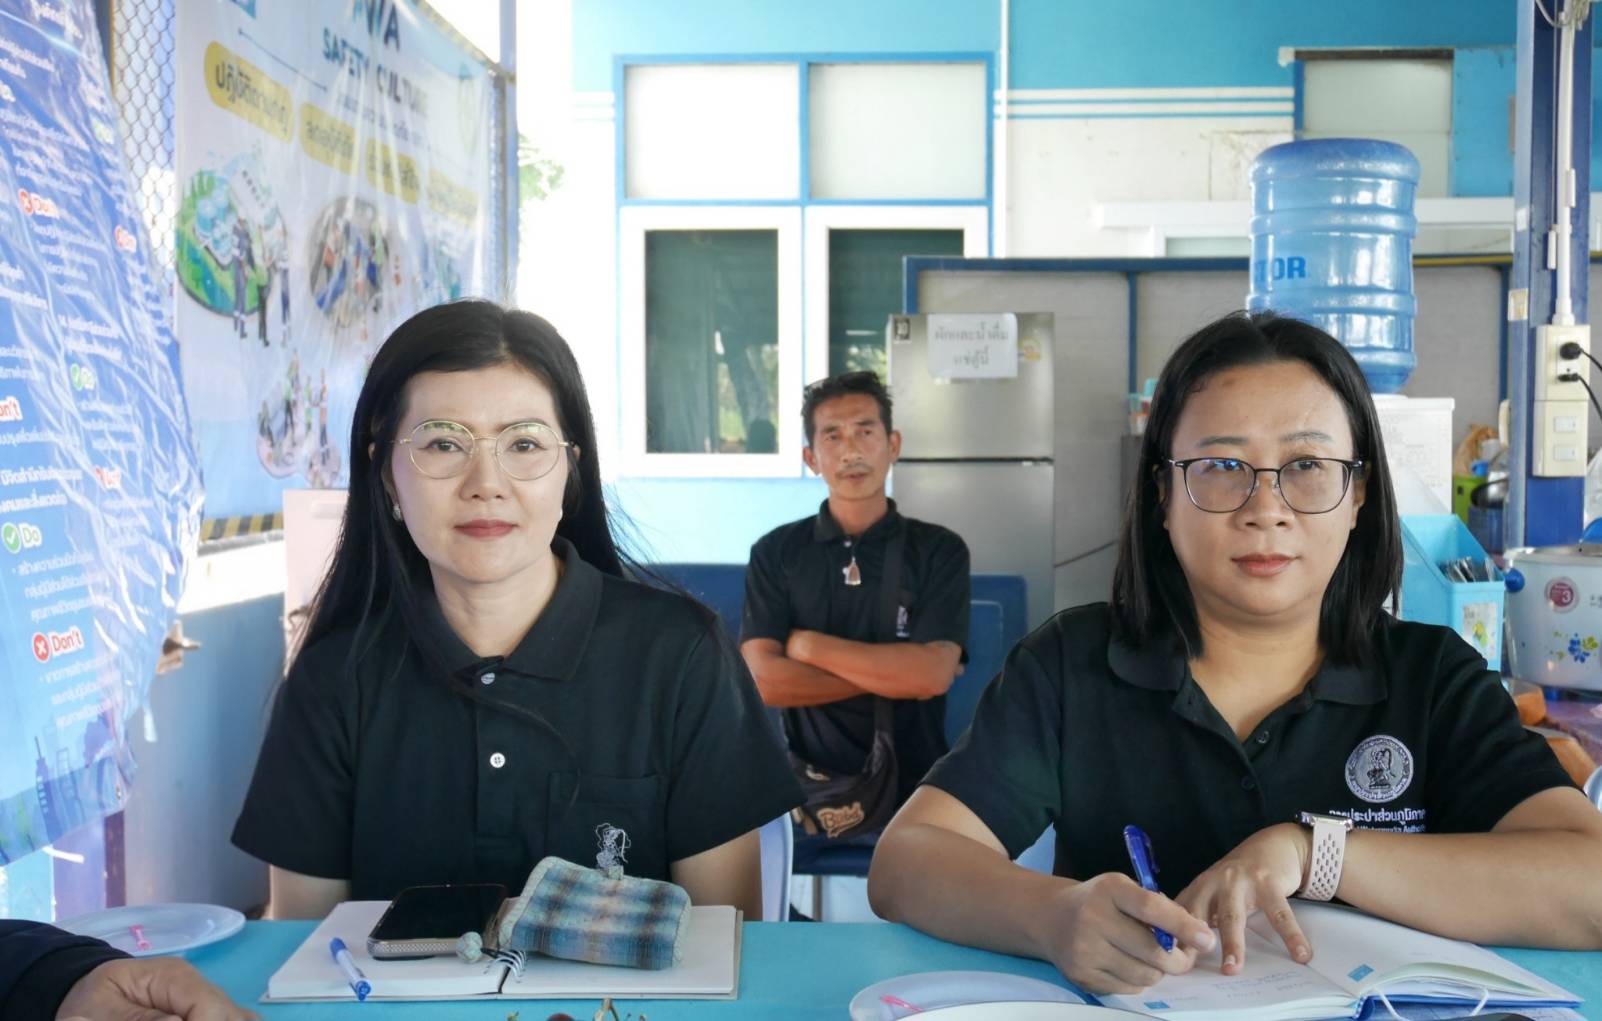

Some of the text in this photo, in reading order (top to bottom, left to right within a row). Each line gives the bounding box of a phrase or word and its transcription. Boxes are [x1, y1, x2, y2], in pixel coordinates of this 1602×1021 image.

[22, 524, 40, 544] Do
[1562, 590, 1571, 603] 3
[51, 630, 83, 652] Don't
